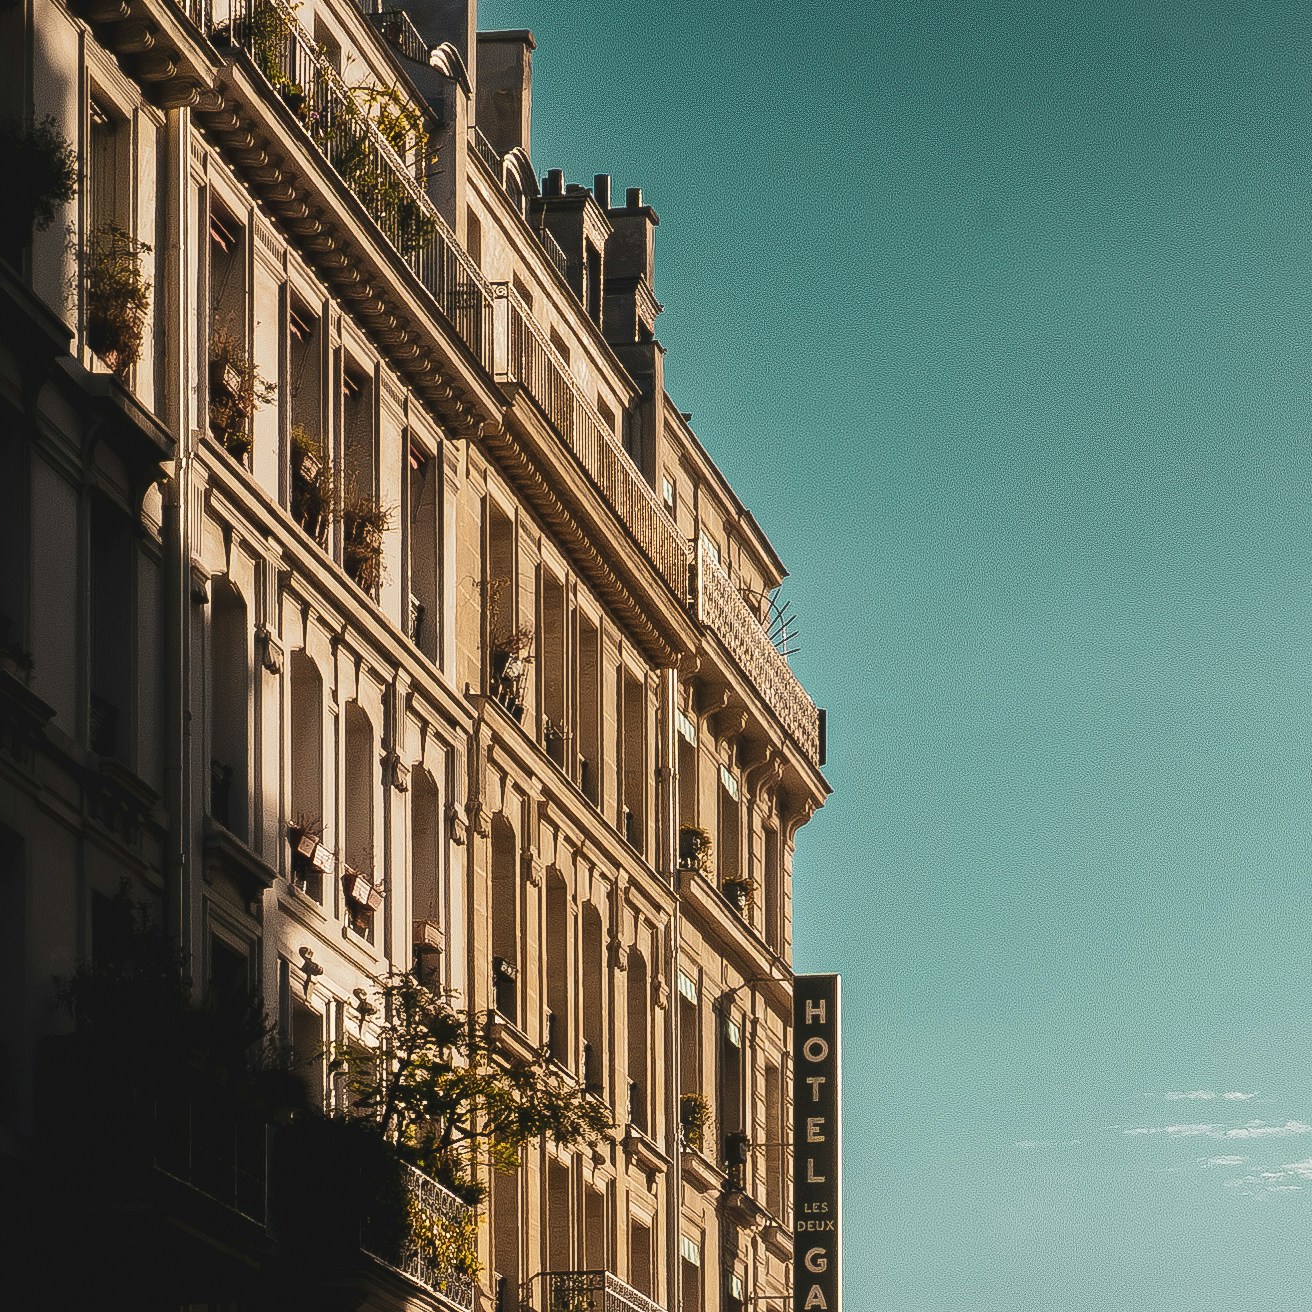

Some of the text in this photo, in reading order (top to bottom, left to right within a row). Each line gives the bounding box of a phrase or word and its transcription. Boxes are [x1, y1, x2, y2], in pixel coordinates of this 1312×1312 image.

[803, 998, 829, 1185] HOTEL
[804, 1202, 829, 1214] LES
[797, 1220, 835, 1232] DEUX
